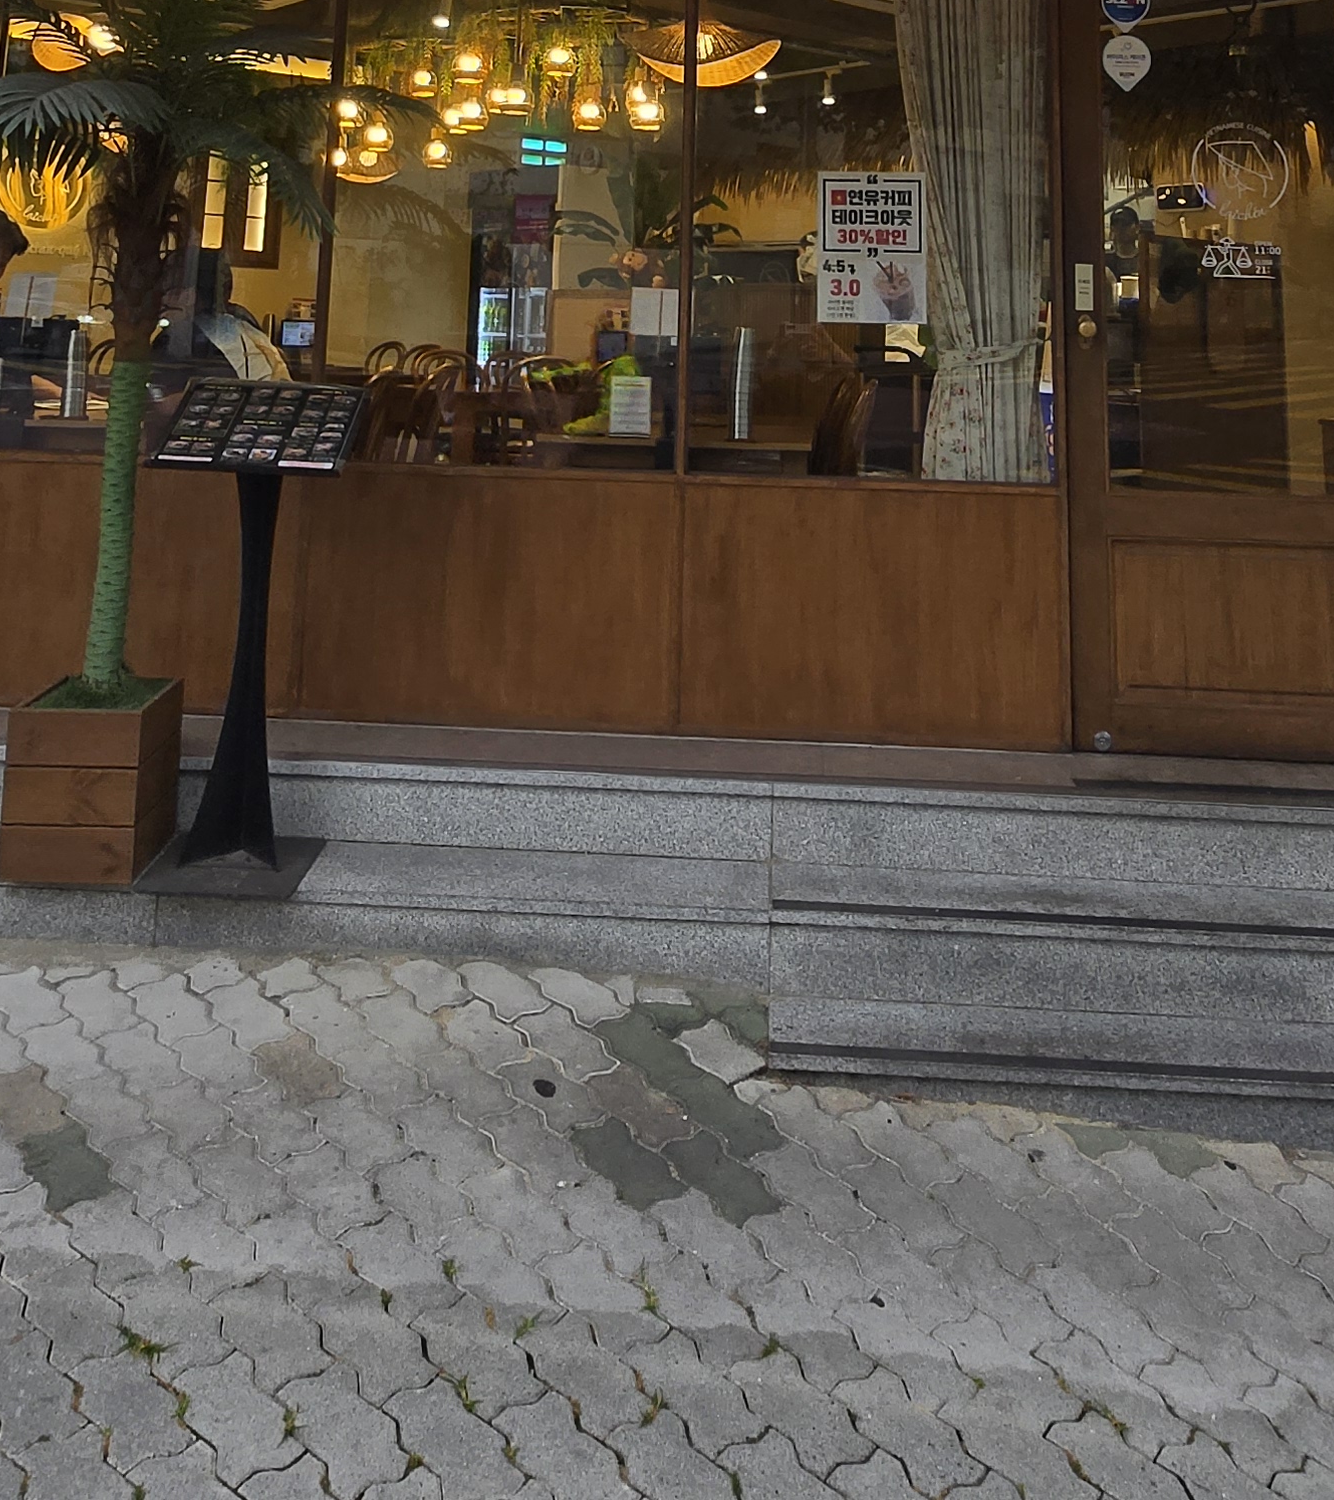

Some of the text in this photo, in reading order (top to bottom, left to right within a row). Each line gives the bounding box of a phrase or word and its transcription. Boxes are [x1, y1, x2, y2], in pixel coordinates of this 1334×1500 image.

[848, 190, 913, 206] 연유커피
[831, 209, 913, 226] 테이크아웃
[837, 229, 907, 245] 30%할인
[1255, 246, 1281, 255] 11:00
[830, 278, 861, 297] 3.0
